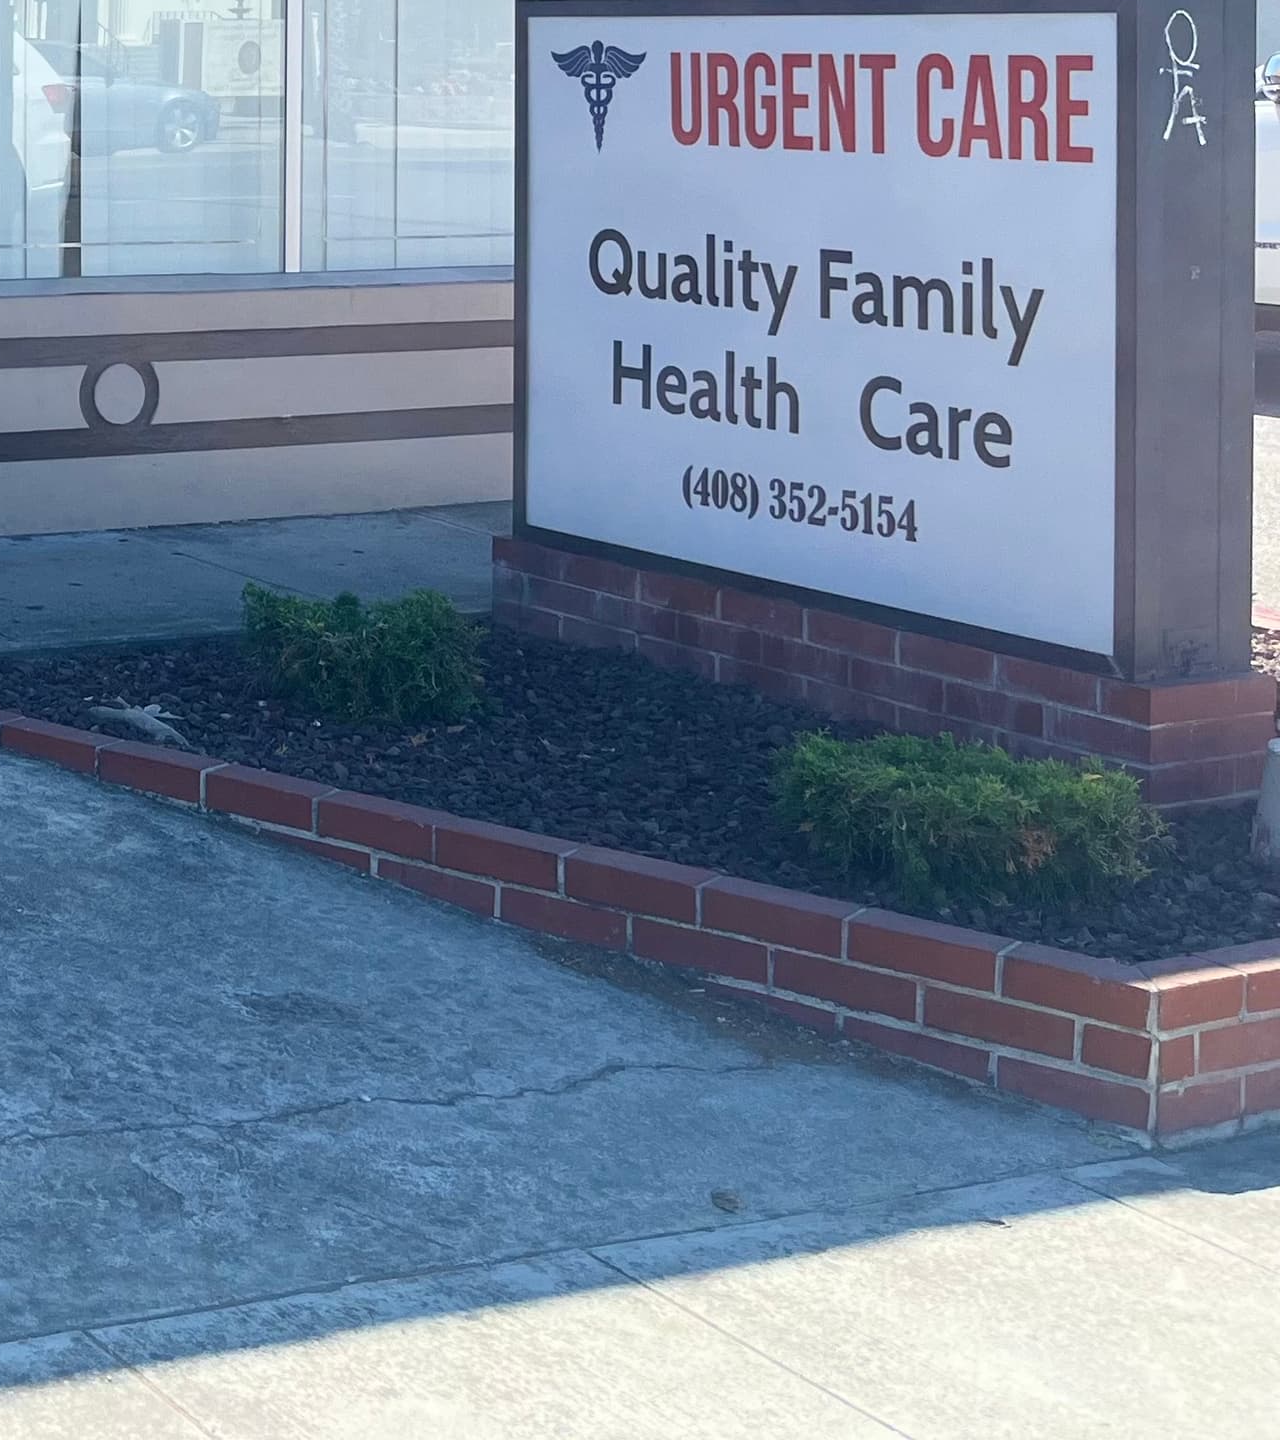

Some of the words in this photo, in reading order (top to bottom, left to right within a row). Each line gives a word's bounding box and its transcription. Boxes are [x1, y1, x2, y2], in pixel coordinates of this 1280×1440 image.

[669, 52, 896, 154] URGENT
[916, 53, 1094, 163] CARE
[589, 228, 798, 336] Quality
[819, 249, 1044, 365] Family
[612, 340, 800, 433] Health
[859, 376, 1012, 468] Care
[682, 464, 760, 520] (408)
[768, 478, 918, 542] 352-5154
